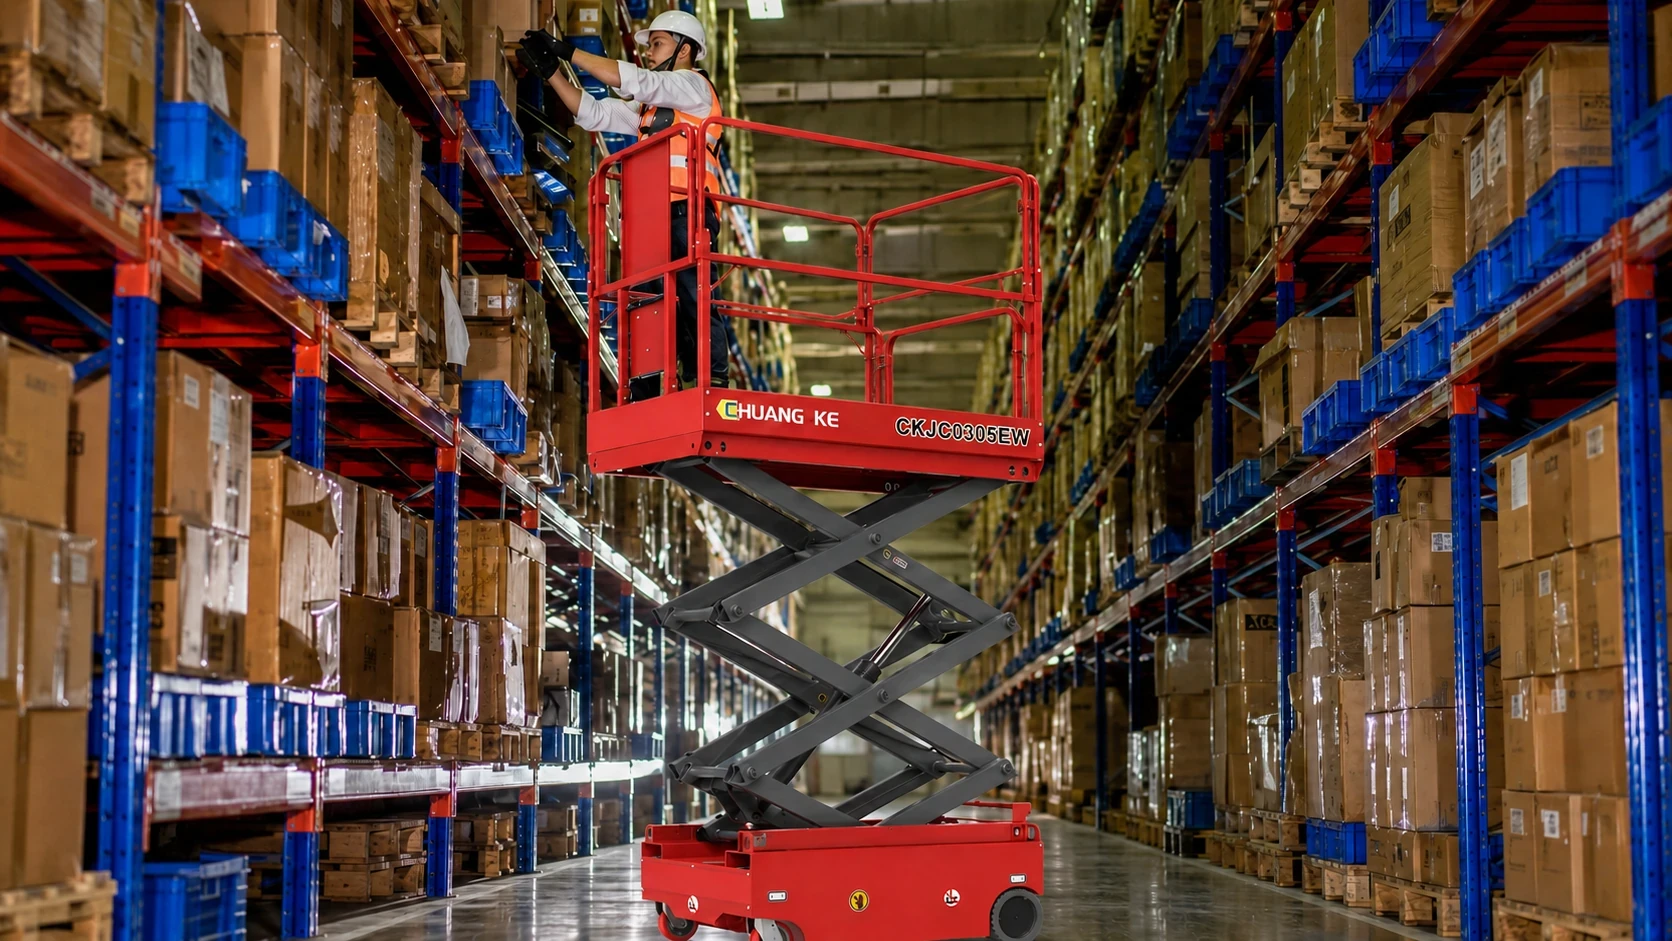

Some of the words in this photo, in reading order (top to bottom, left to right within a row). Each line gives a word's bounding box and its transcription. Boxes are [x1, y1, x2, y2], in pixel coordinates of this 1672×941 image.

[717, 400, 804, 425] CHUANG
[814, 410, 839, 427] KE
[895, 416, 1030, 446] CKJC0305EW
